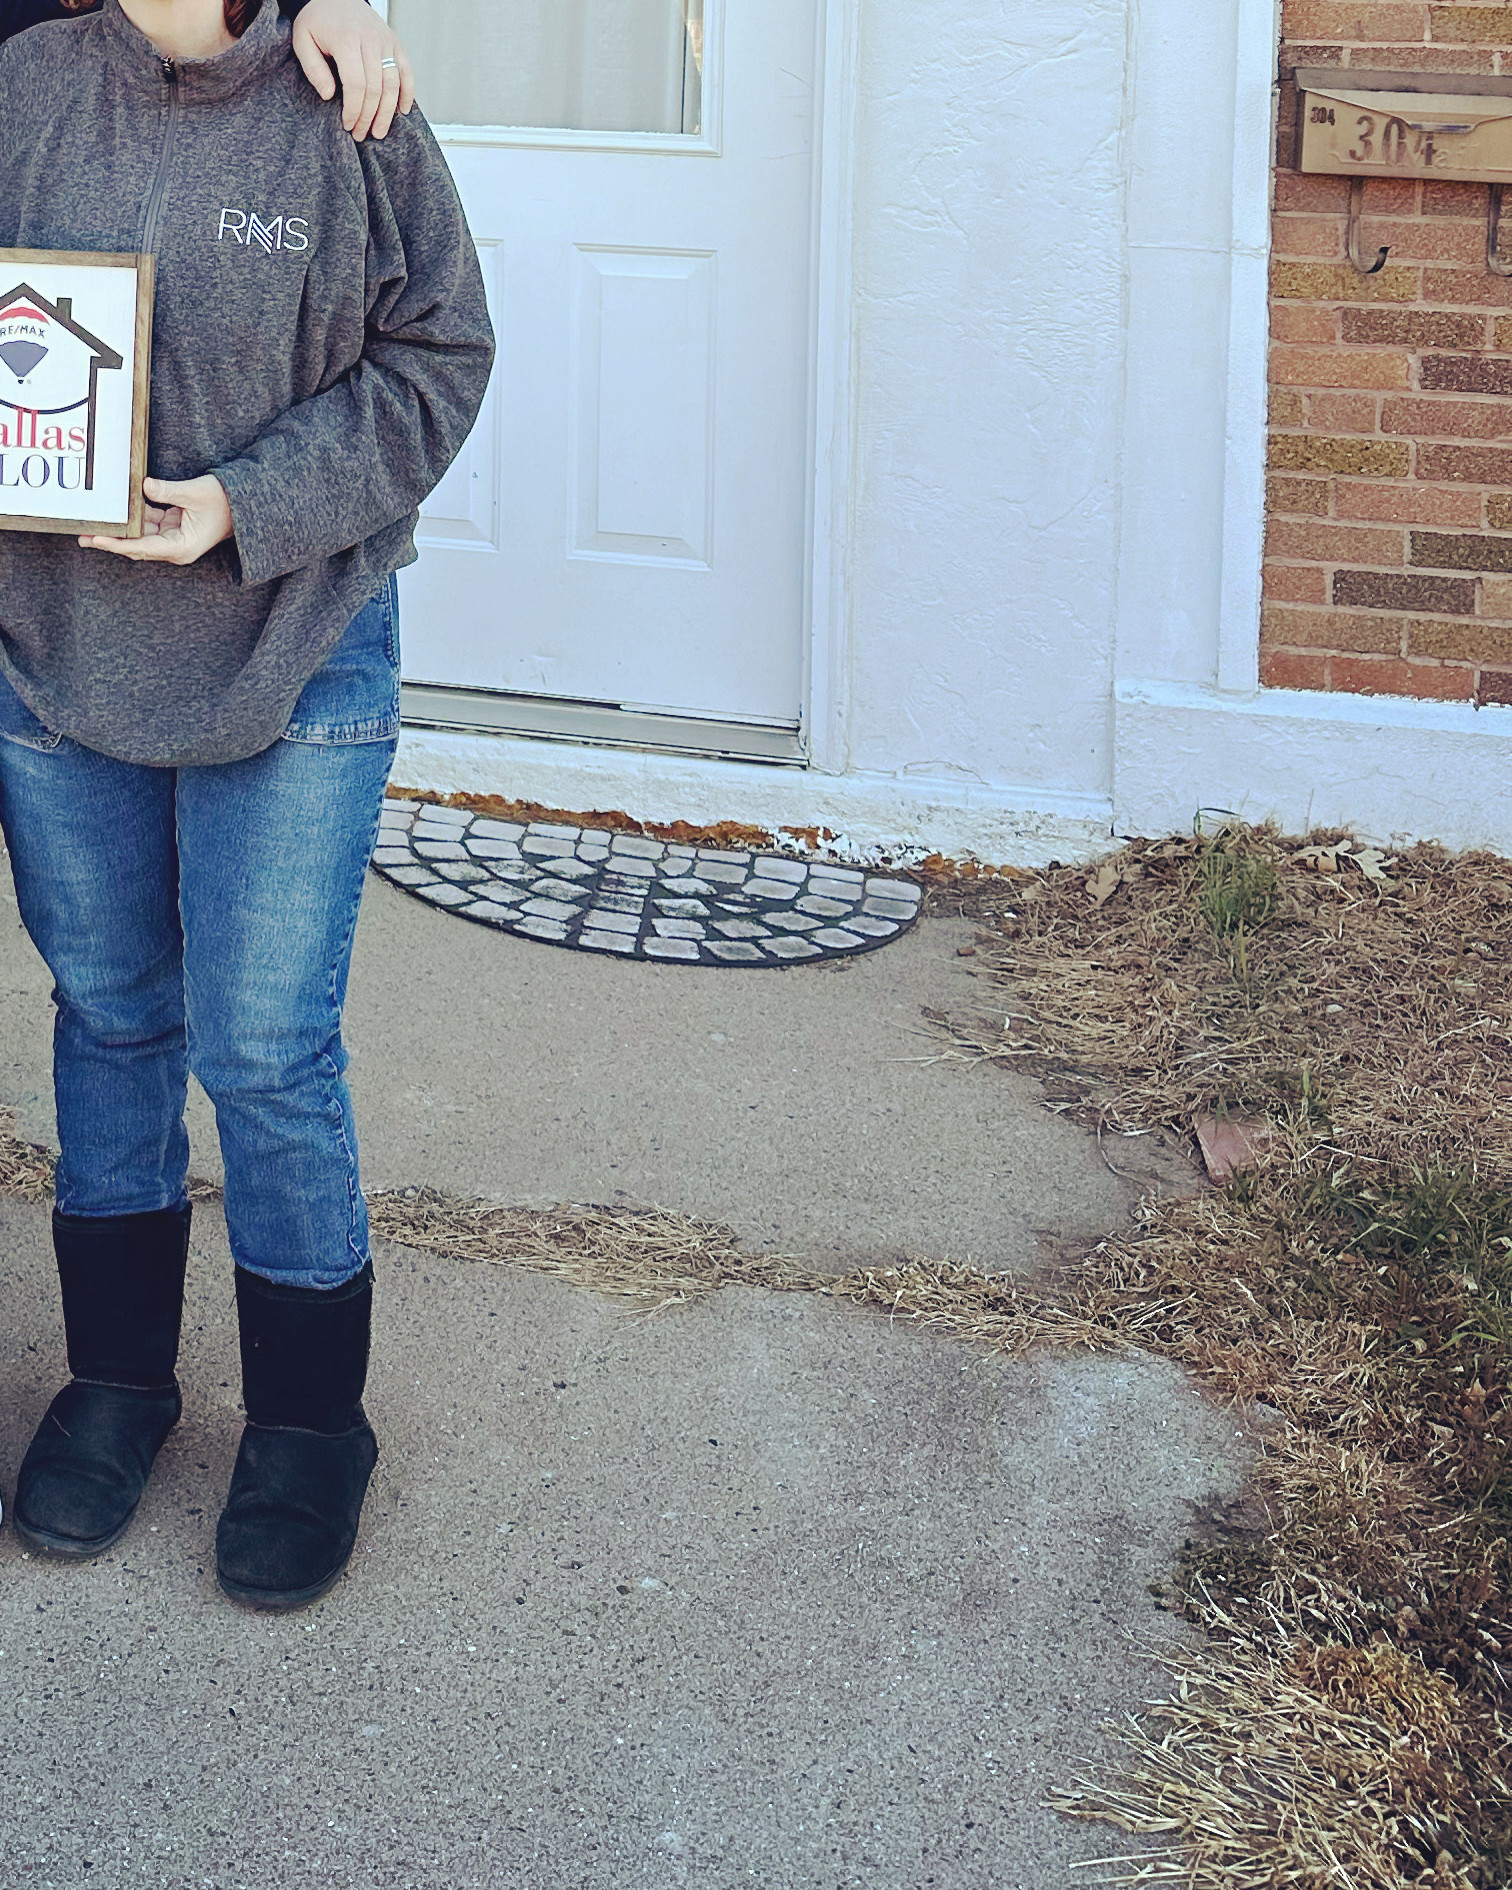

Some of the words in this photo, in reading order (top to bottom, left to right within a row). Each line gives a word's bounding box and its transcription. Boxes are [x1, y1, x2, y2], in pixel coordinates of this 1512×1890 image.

[1310, 106, 1336, 126] 304
[218, 207, 309, 254] RMS
[0, 325, 45, 339] RE/MAX
